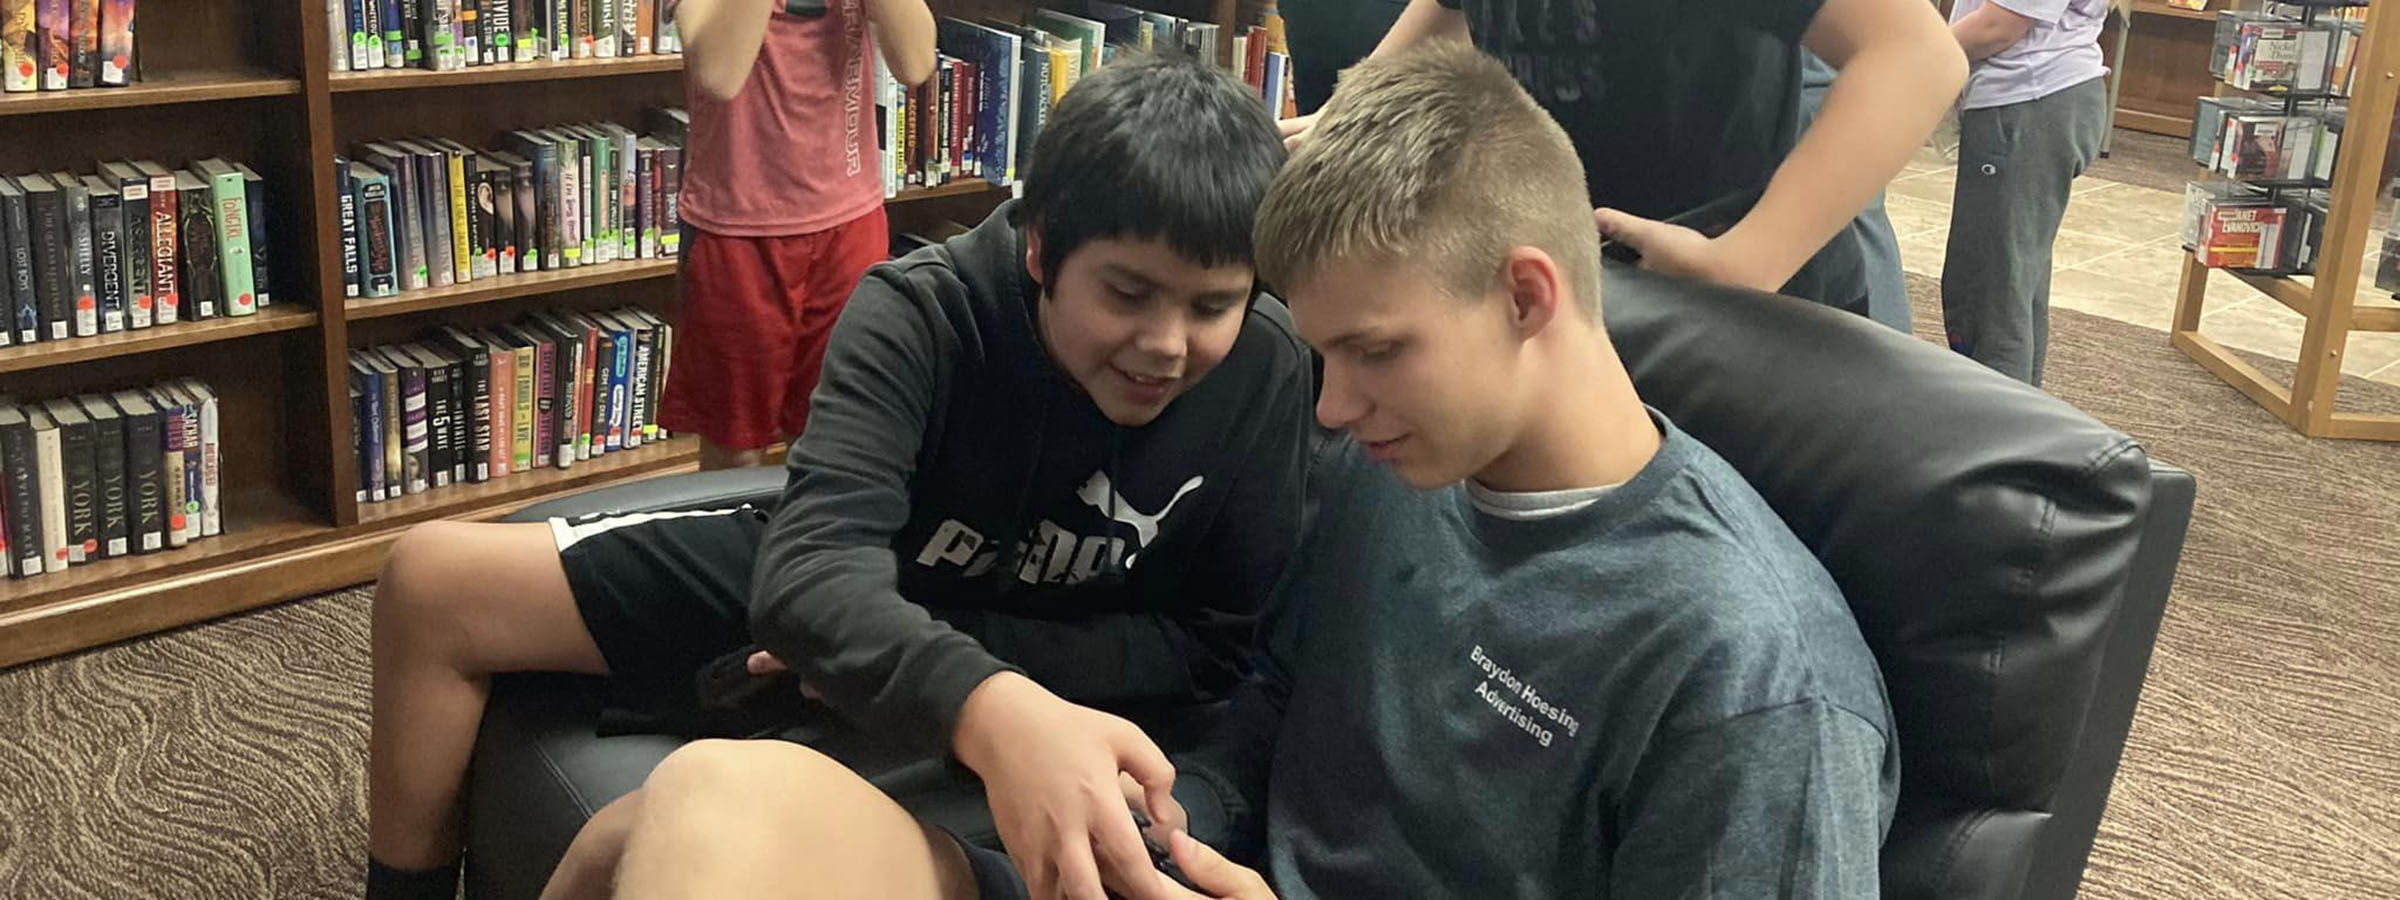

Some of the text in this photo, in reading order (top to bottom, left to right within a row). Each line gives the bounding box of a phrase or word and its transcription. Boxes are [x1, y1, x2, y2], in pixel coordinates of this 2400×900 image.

[493, 0, 509, 33] IVIDE
[843, 32, 863, 178] ARMOUR
[908, 98, 917, 148] ACCEPTED
[16, 247, 27, 268] LOST
[78, 236, 91, 276] SHELLY
[156, 211, 174, 294] ALLEGIANT
[341, 194, 358, 273] GREAT FALLS
[101, 231, 120, 310] DIVERGENT
[601, 367, 610, 385] GEM
[632, 345, 650, 433] AMERICAN STREET
[181, 412, 199, 449] SACHAR
[435, 399, 447, 415] THE
[454, 410, 466, 451] INFINITE
[475, 379, 490, 452] THE LAST STAR
[436, 427, 448, 451] WAVE
[72, 480, 92, 536] YORK
[104, 474, 125, 528] YORK
[139, 469, 159, 524] YORK
[1470, 644, 1580, 737] Braydon Hoesing
[1474, 680, 1553, 747] Advertising
